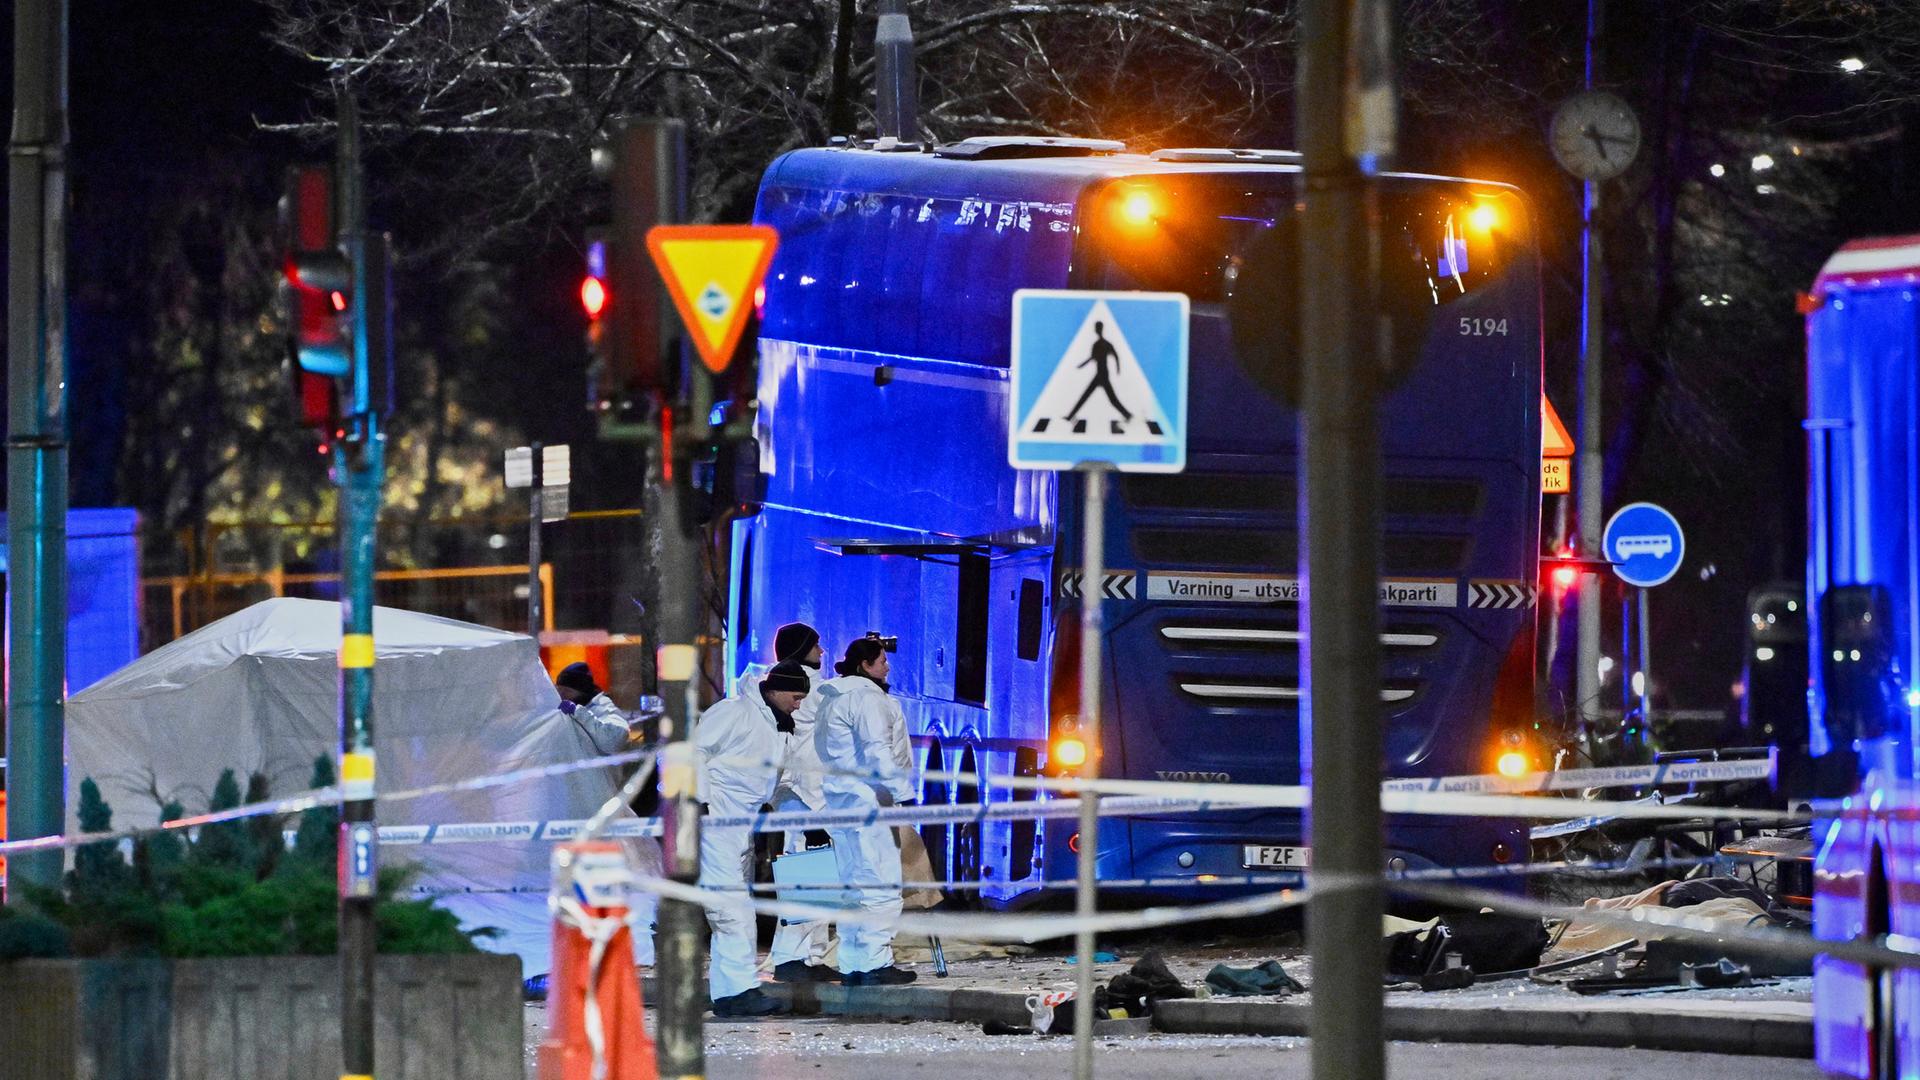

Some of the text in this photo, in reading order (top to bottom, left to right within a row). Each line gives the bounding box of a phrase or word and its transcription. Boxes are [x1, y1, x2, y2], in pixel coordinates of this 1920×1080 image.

[1459, 317, 1508, 337] 5194
[1167, 579, 1234, 599] Varning
[1260, 847, 1294, 865] FZF
